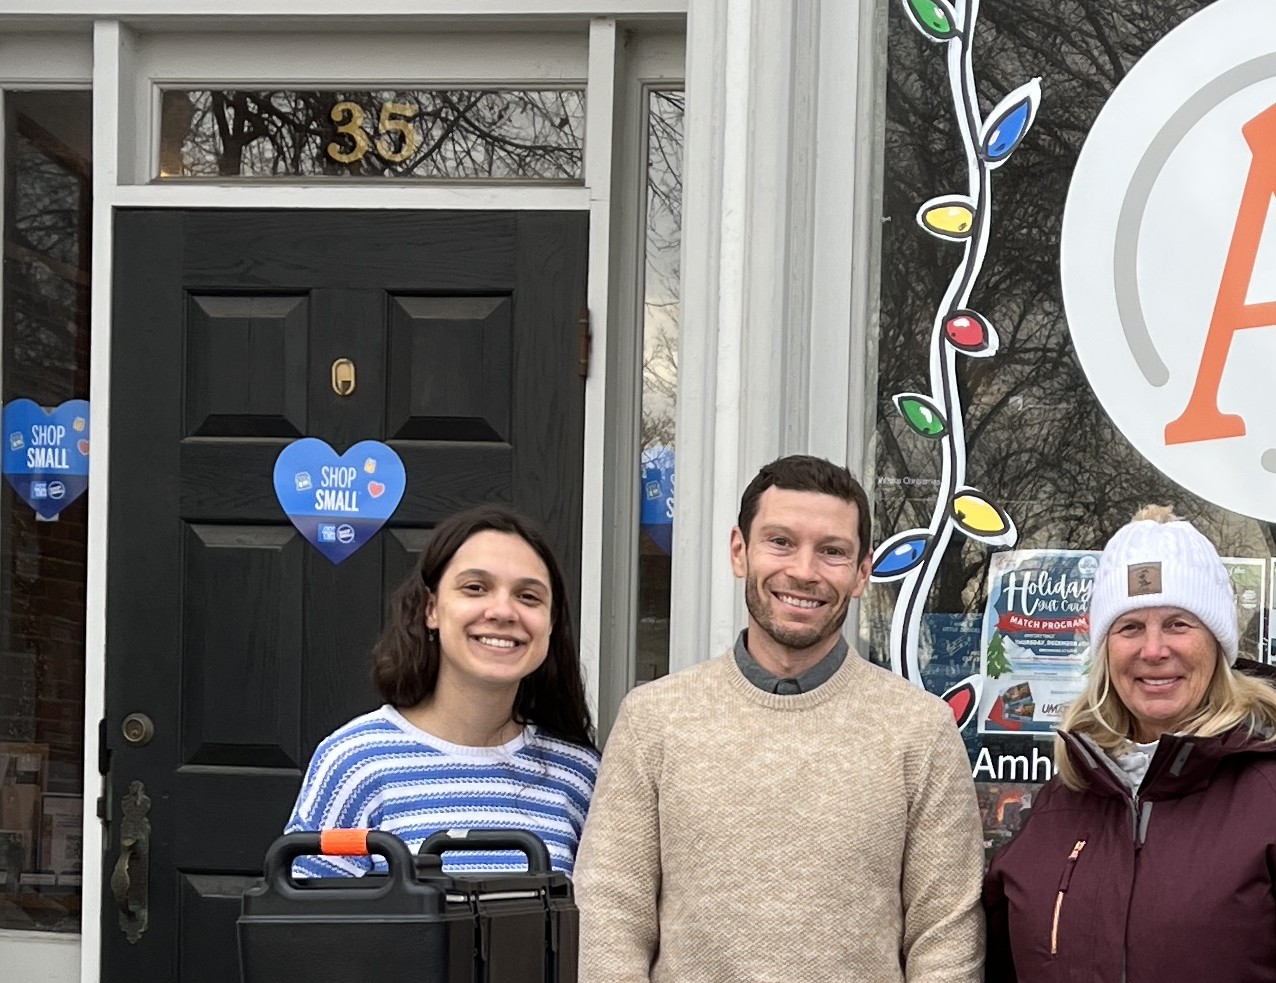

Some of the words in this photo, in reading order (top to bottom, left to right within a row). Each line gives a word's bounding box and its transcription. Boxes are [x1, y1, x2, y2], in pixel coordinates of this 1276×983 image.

[327, 101, 420, 164] 35
[31, 424, 66, 446] SHOP
[26, 447, 70, 469] SMALL
[320, 465, 358, 488] SHOP
[314, 488, 360, 513] SMALL
[1003, 571, 1093, 616] Holiday
[1037, 599, 1059, 612] Gift
[1060, 599, 1089, 613] Card
[1009, 616, 1040, 629] MATCH
[1041, 617, 1089, 630] PROGRAM
[972, 747, 1059, 781] Amh
